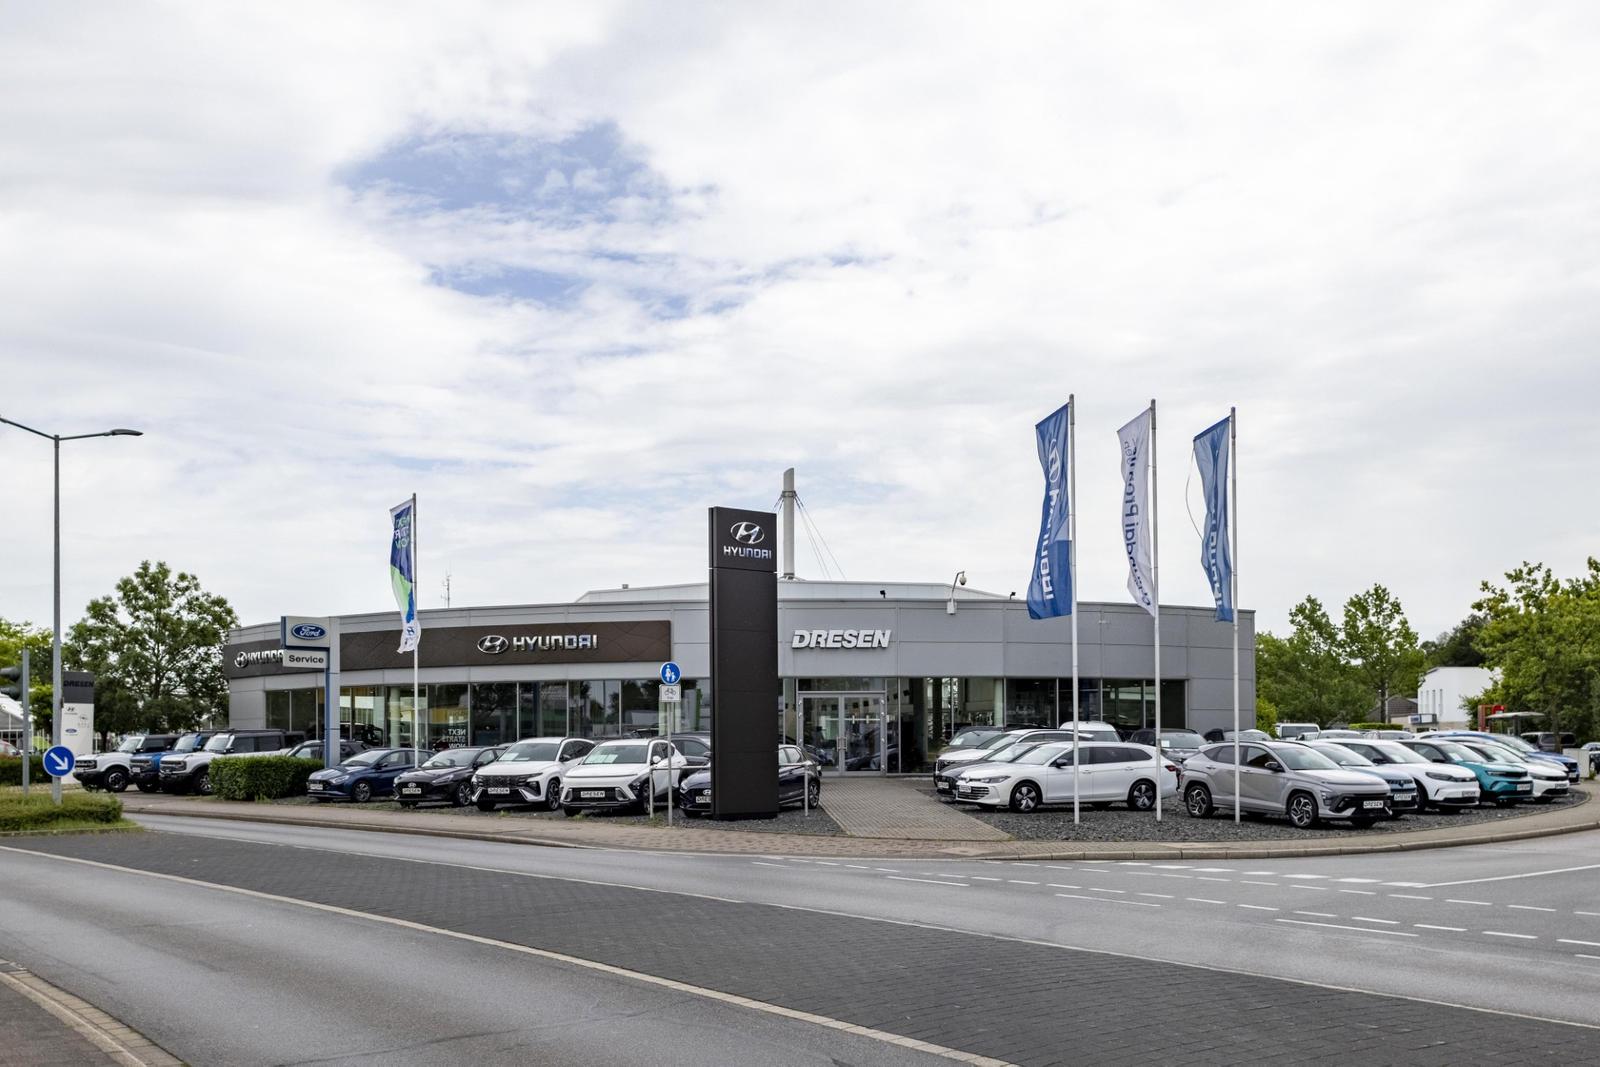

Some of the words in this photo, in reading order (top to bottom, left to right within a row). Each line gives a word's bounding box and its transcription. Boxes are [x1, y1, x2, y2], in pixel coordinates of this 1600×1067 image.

[723, 545, 772, 560] HYUNDAI
[299, 626, 321, 638] Ford
[791, 629, 892, 649] DRESEN
[512, 634, 598, 651] HYUNDAI
[247, 649, 284, 664] HYUNDA
[288, 654, 325, 664] Service
